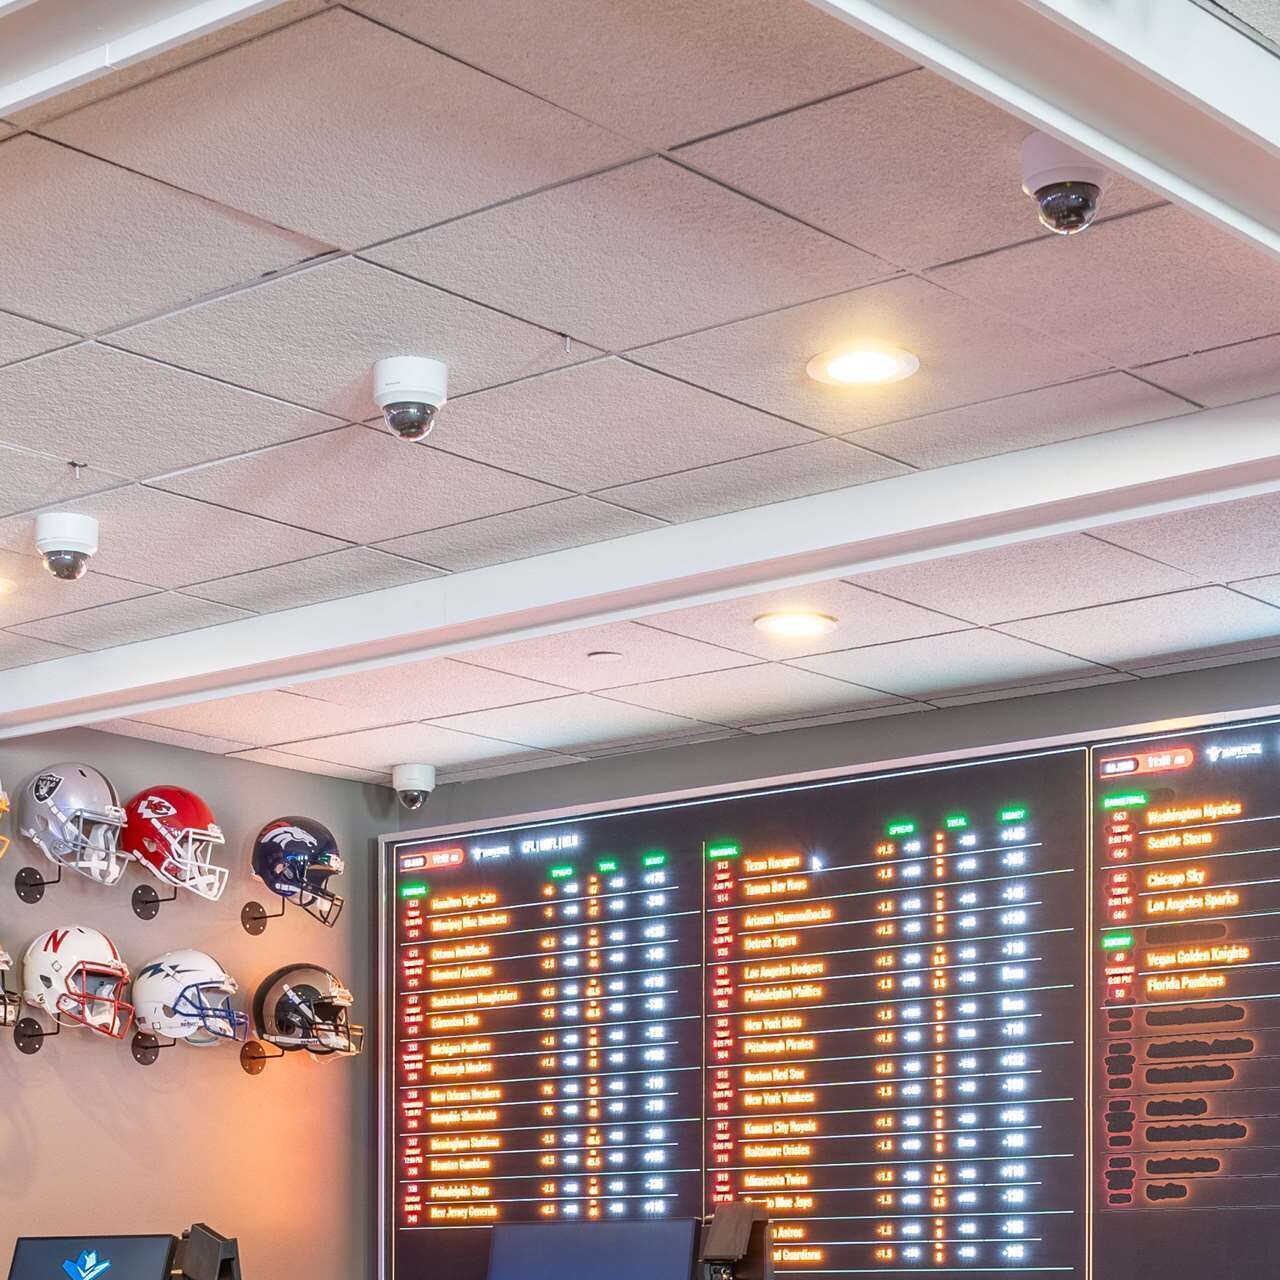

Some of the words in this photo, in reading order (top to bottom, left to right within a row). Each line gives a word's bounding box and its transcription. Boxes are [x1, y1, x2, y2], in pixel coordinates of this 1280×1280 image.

[1148, 807, 1200, 824] Washington
[1201, 802, 1241, 818] Mystics
[1148, 835, 1179, 848] Seattle
[1182, 831, 1211, 845] Storm
[1148, 873, 1180, 887] Chicago
[1181, 870, 1204, 885] Sky
[1148, 900, 1164, 913] Los
[1167, 898, 1201, 913] Angeles
[1204, 894, 1238, 907] Sparks
[1147, 952, 1174, 968] Vegas
[1177, 950, 1207, 963] Golden
[1208, 947, 1249, 963] Knights
[1147, 978, 1180, 991] Florida
[1181, 975, 1224, 989] Panthers
